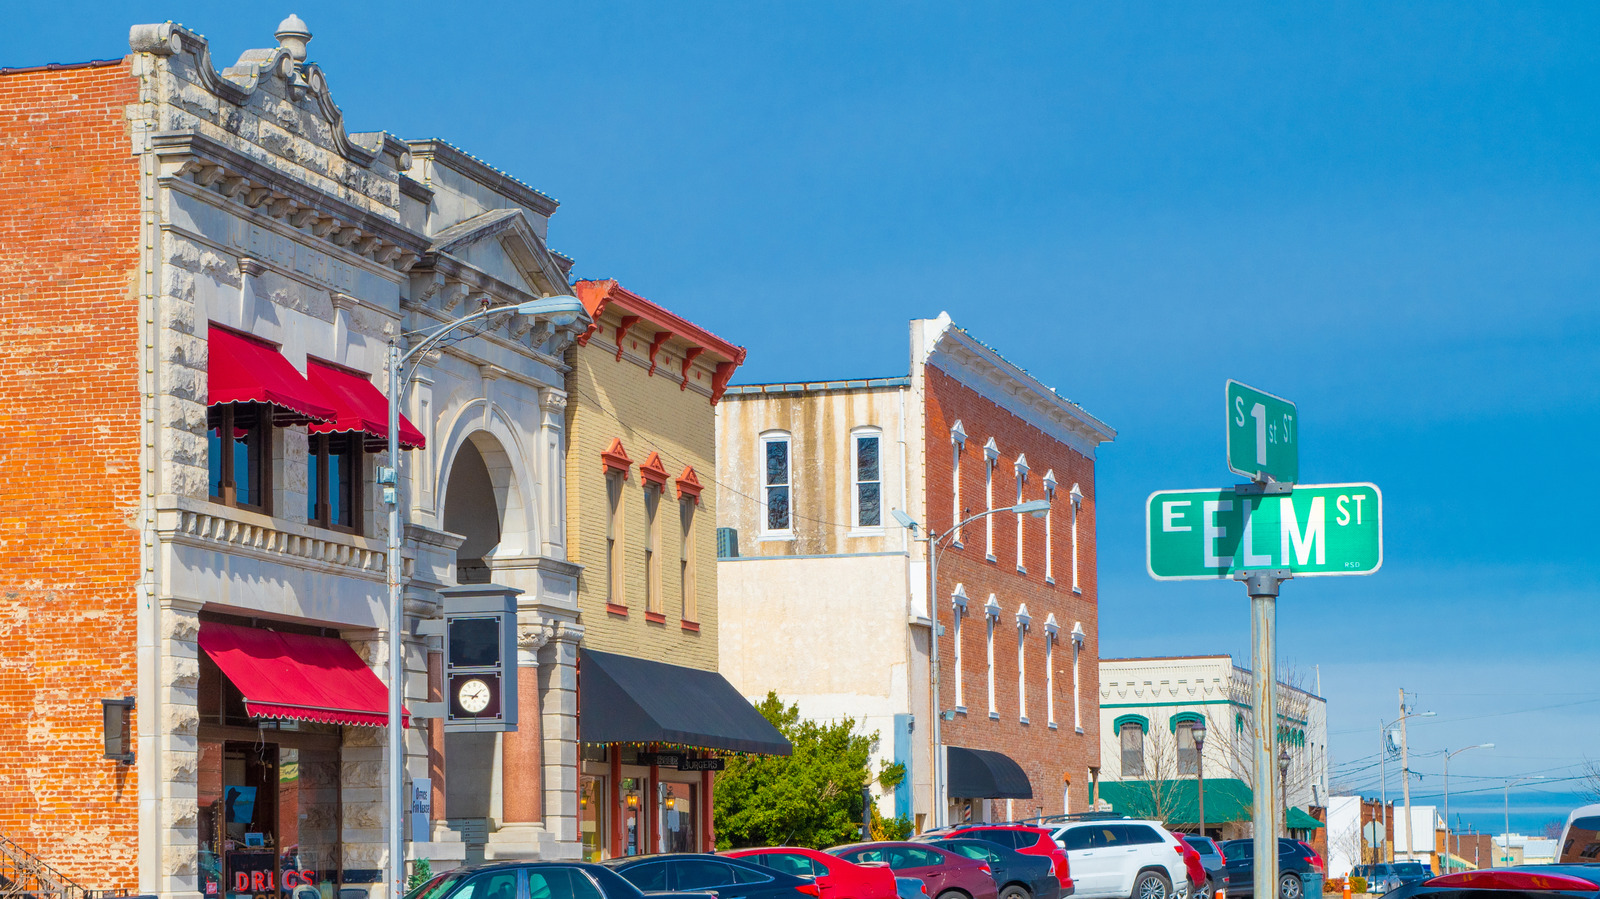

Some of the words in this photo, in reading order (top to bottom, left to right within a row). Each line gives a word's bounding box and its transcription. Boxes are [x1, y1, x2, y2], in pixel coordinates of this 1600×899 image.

[1235, 396, 1246, 428] S
[1282, 413, 1293, 444] ST
[1162, 501, 1192, 533] E
[1203, 496, 1326, 568] ELM
[1336, 494, 1366, 526] ST
[682, 759, 718, 770] BURGERS
